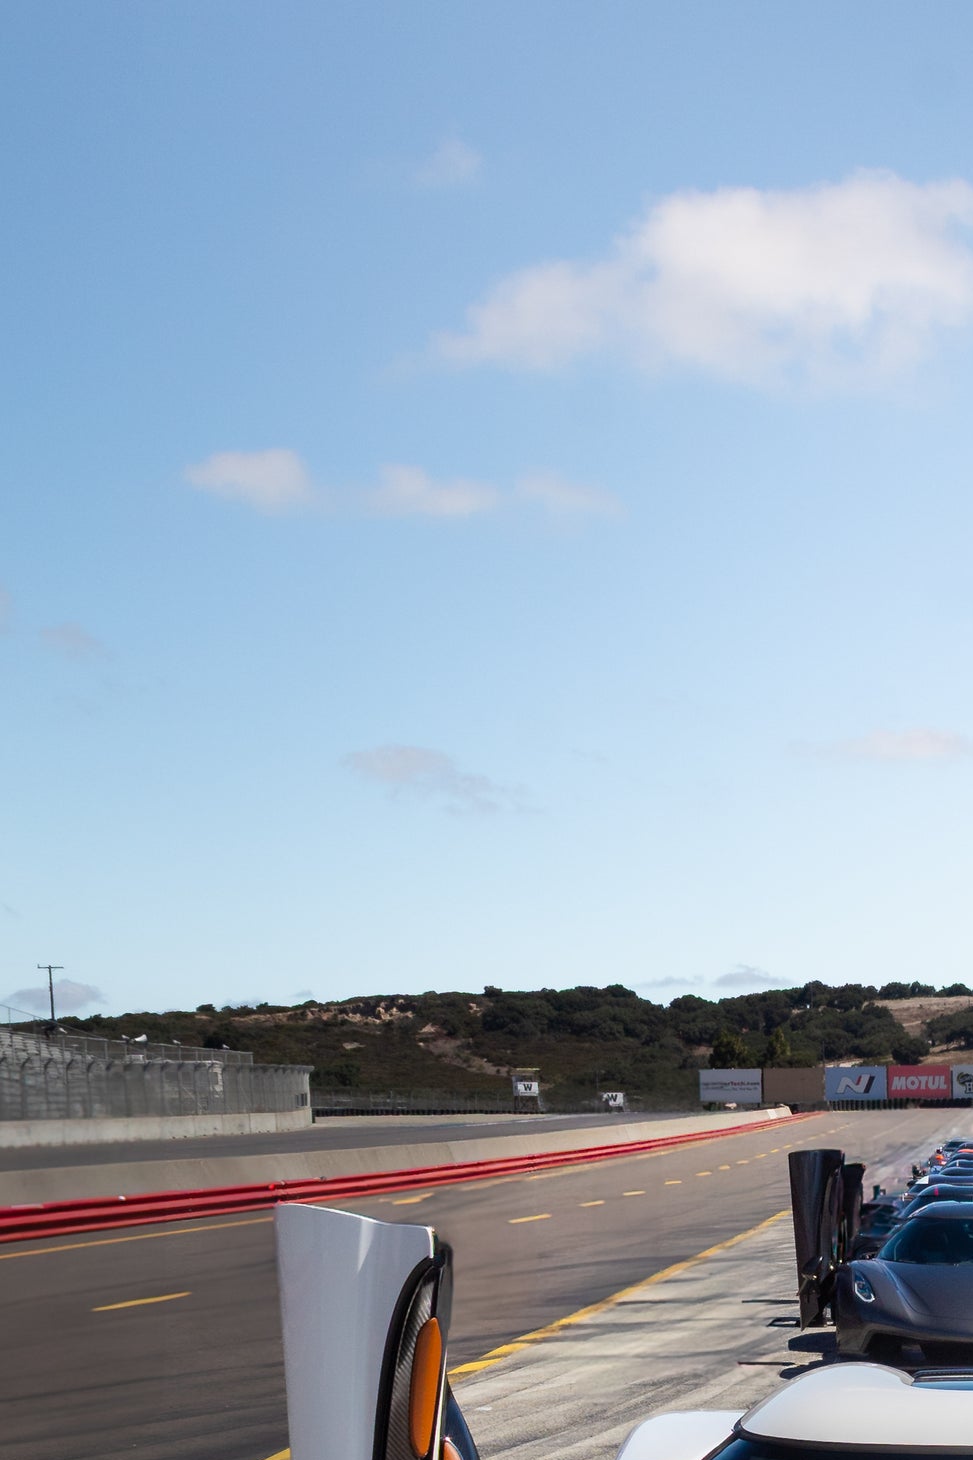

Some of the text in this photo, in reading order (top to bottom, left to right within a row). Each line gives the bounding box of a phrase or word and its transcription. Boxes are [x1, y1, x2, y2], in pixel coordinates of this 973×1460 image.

[523, 1083, 533, 1091] W
[891, 1075, 947, 1091] MOTUL
[607, 1093, 617, 1102] W
